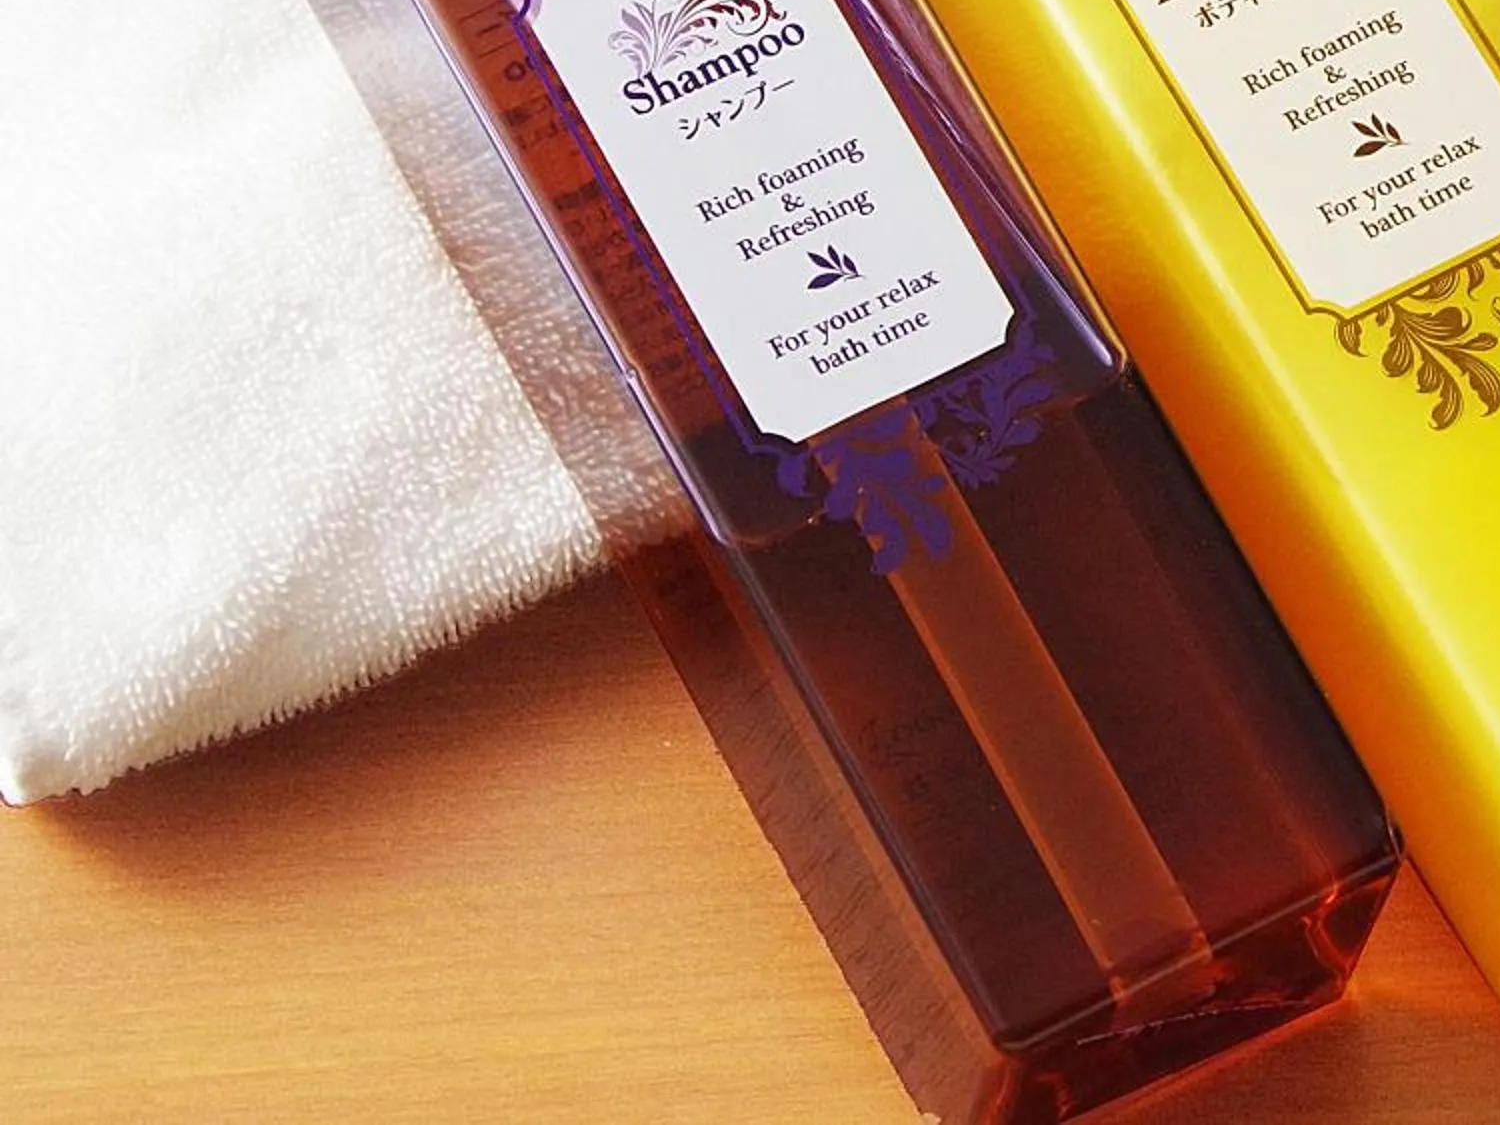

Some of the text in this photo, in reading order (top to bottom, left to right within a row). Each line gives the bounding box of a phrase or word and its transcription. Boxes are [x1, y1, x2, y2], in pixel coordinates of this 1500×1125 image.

[623, 21, 805, 114] Shampoo
[1242, 7, 1403, 95] Rich foaming
[1324, 64, 1347, 84] &
[678, 79, 796, 139] シャンプー
[1283, 59, 1415, 131] Refreshing
[697, 135, 865, 223] Rich foaming
[781, 192, 804, 213] &
[1317, 135, 1482, 226] For your relax
[1360, 174, 1474, 239] bath time
[736, 188, 875, 262] Refreshing
[768, 268, 941, 360] For your relax
[810, 308, 930, 375] bath time
